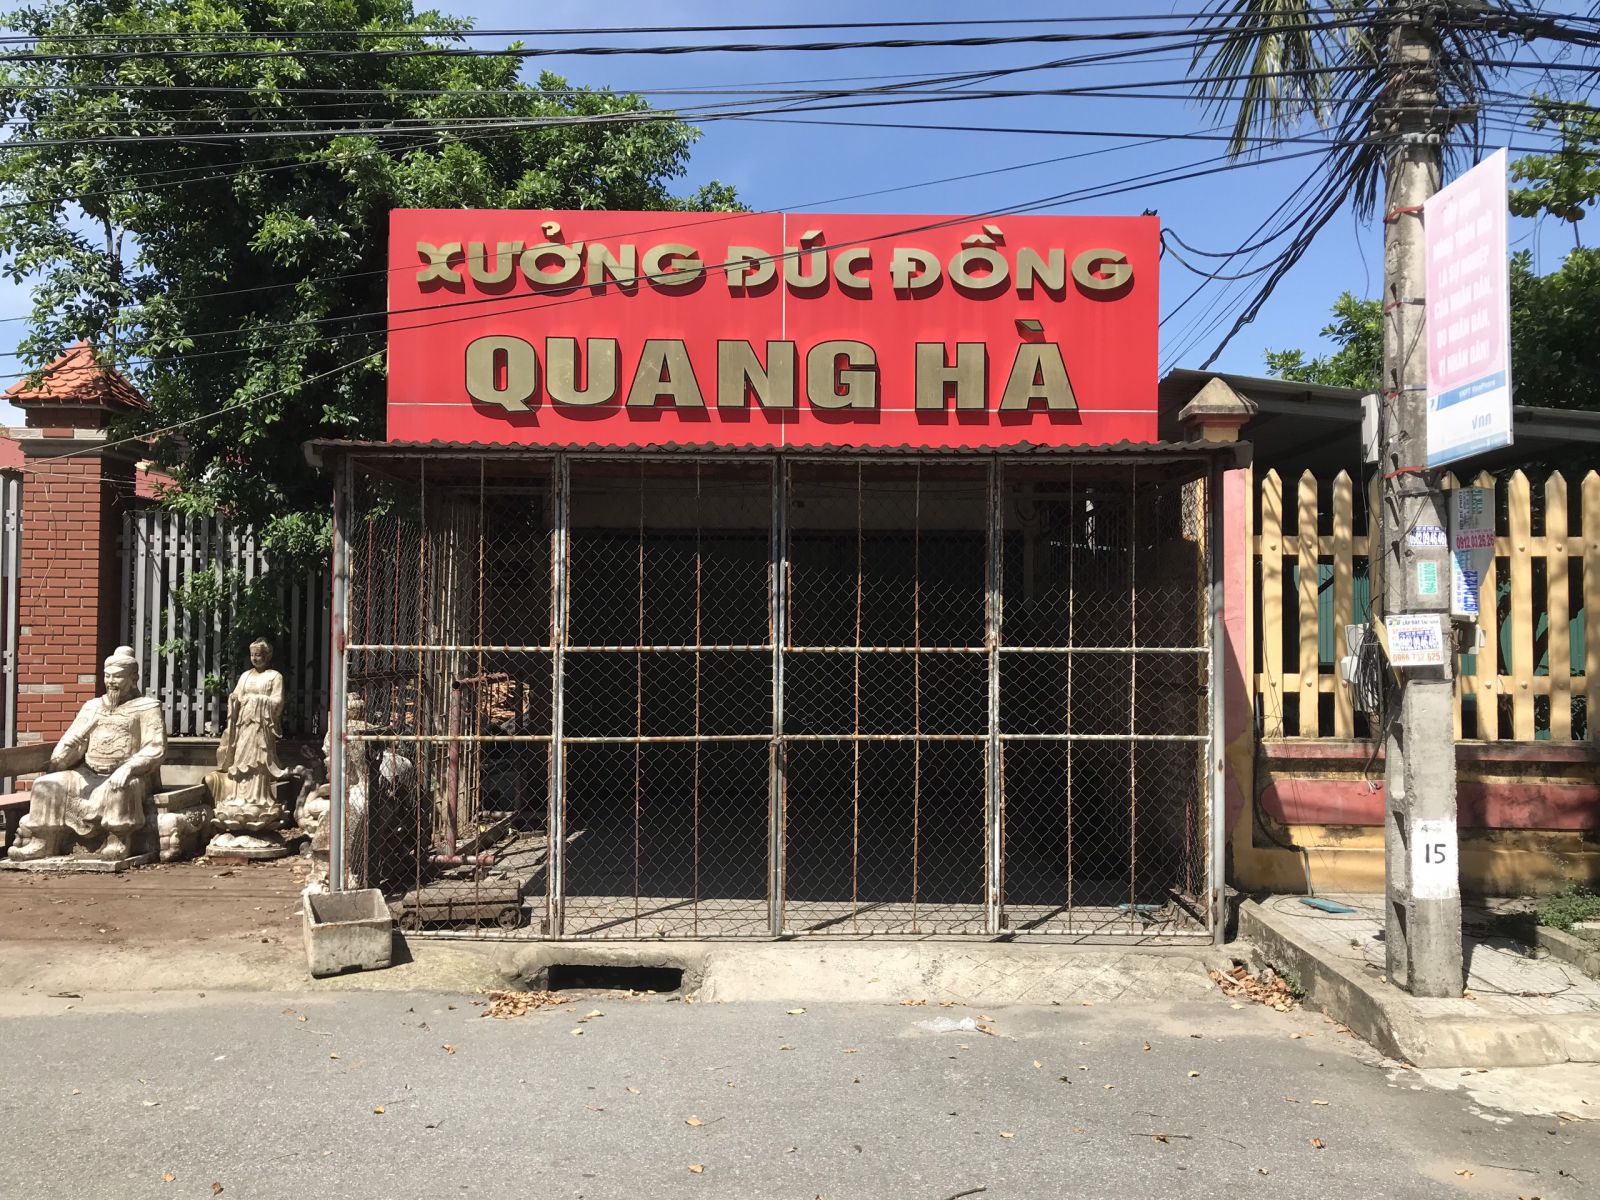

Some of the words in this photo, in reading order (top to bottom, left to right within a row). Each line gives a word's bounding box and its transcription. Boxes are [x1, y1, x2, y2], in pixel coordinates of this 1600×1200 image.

[416, 221, 706, 288] XƯỞNG
[725, 229, 872, 290] ĐỨC
[889, 224, 1135, 292] ĐỒNG
[464, 335, 881, 413] QUANG
[914, 319, 1079, 413] HÀ
[1425, 843, 1447, 864] 15
